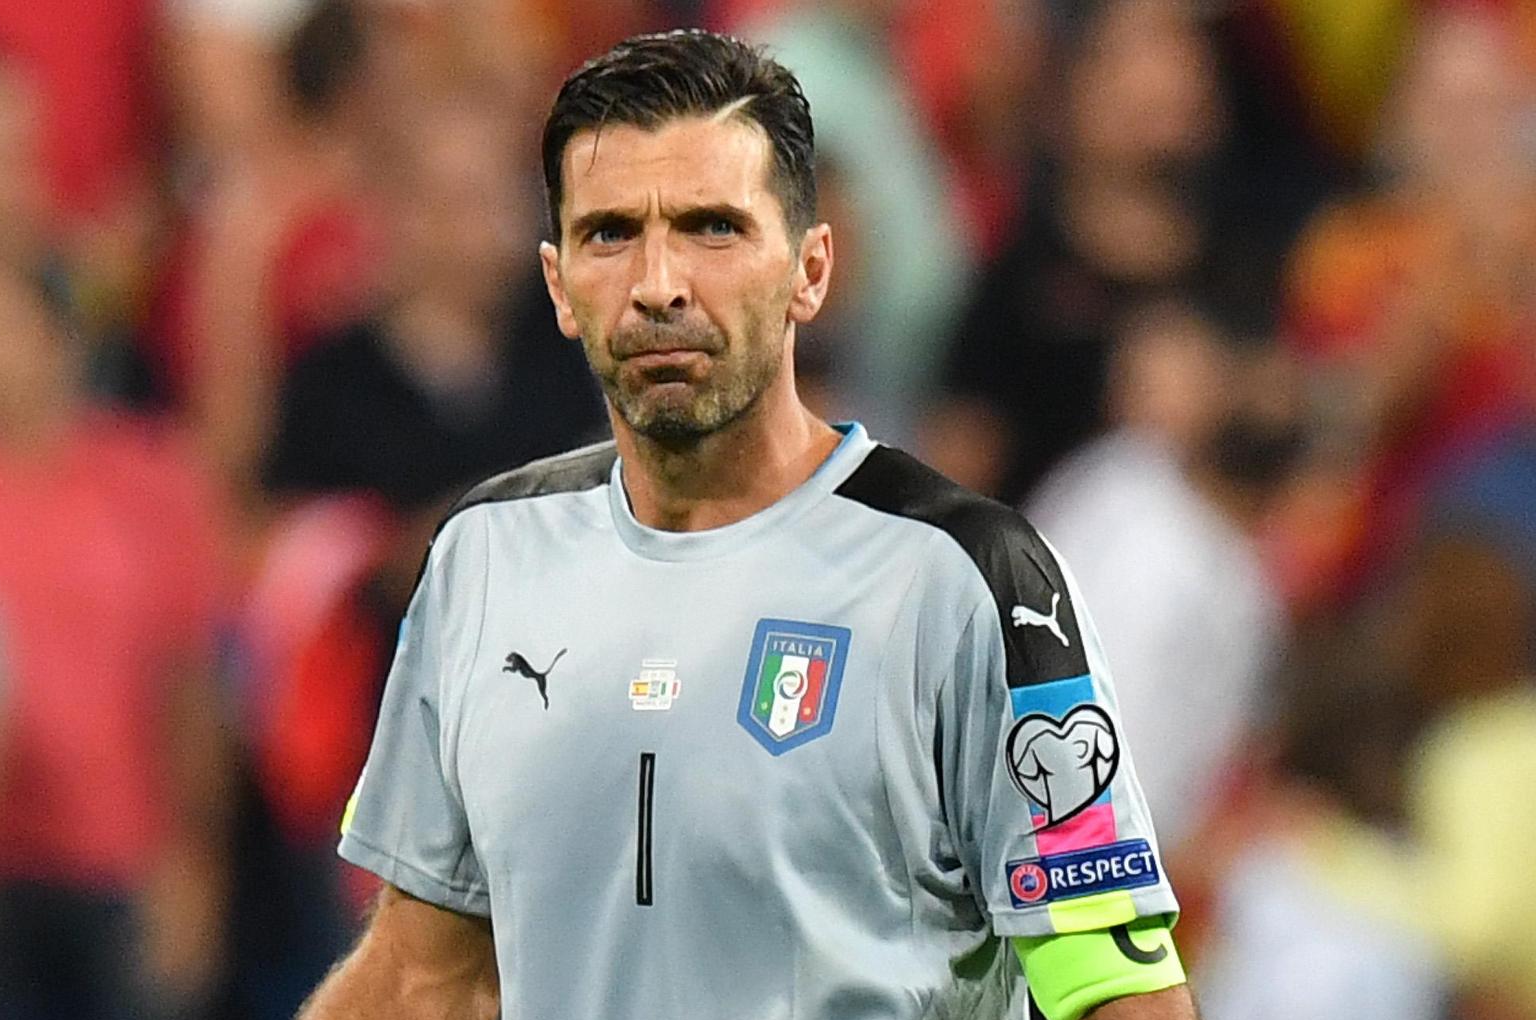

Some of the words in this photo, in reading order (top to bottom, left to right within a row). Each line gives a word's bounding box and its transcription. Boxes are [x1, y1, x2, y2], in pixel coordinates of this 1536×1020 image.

[773, 641, 823, 656] ITALIA
[636, 752, 656, 906] 1
[1049, 851, 1153, 889] RESPECT
